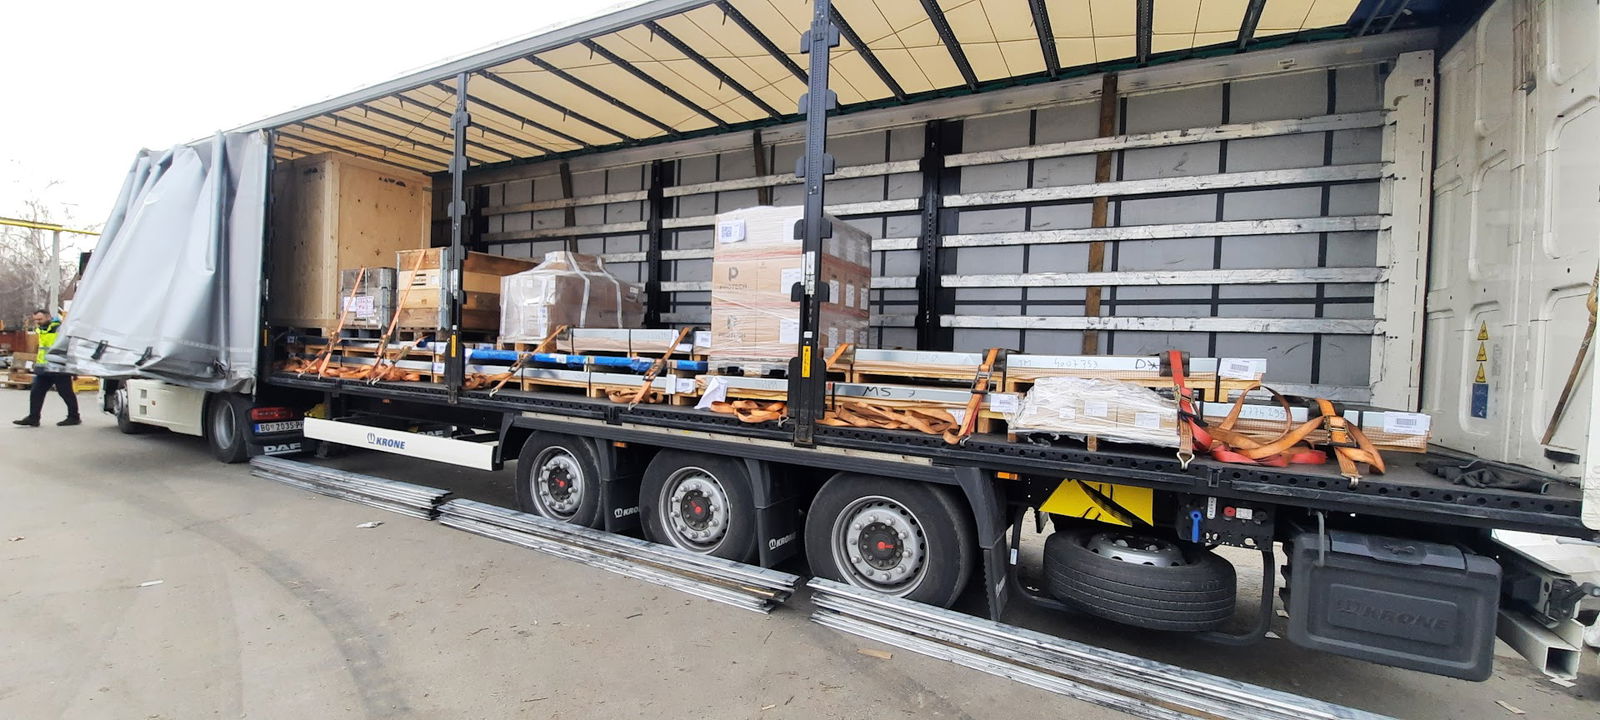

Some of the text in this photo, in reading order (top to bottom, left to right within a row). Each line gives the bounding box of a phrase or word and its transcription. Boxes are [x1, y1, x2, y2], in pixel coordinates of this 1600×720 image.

[862, 386, 892, 397] MS
[260, 424, 271, 432] BG
[263, 442, 302, 452] DAF
[376, 437, 406, 449] KRONE
[623, 506, 639, 516] KRO
[1363, 606, 1450, 630] KRONE
